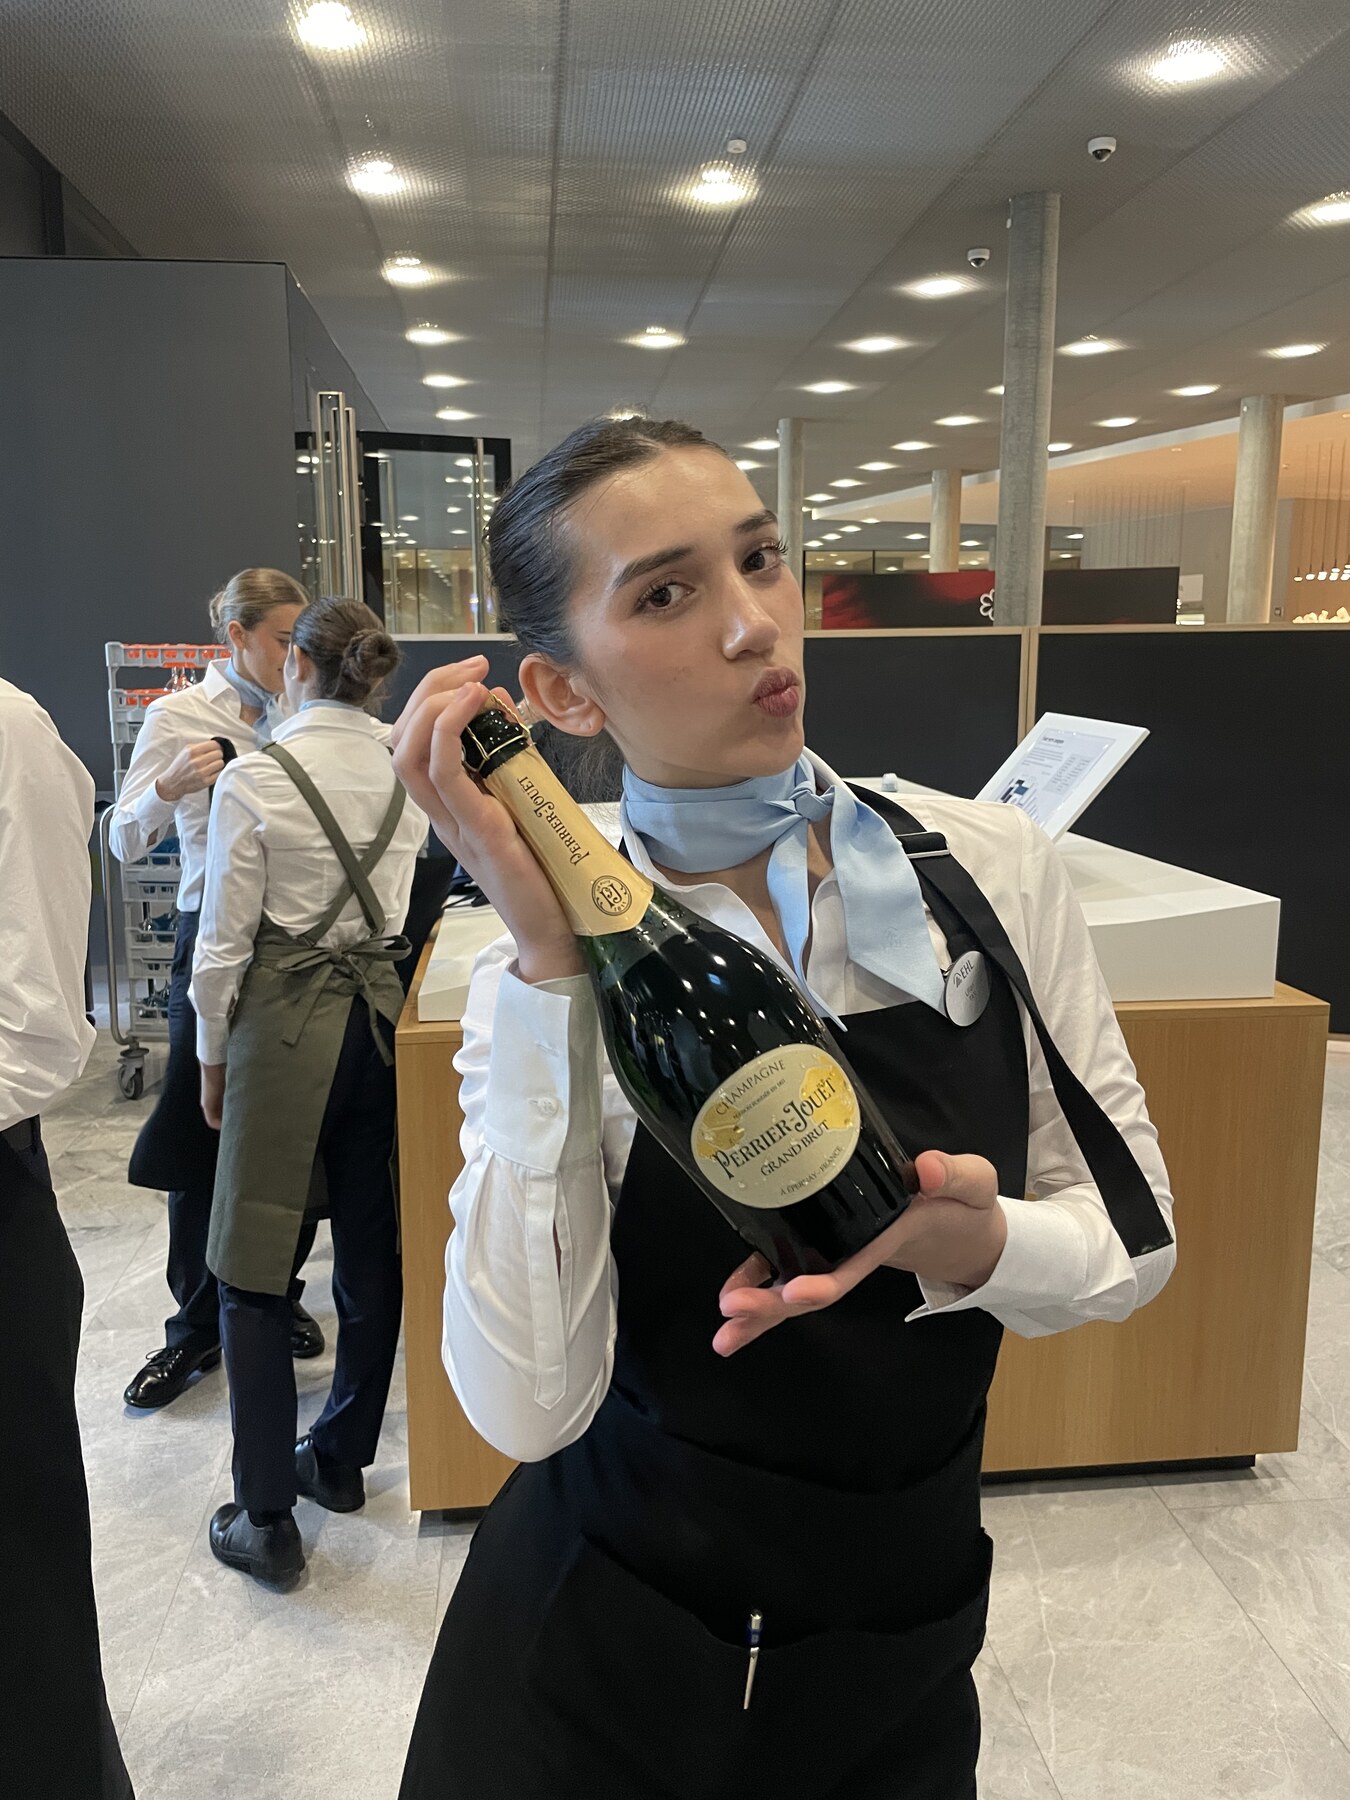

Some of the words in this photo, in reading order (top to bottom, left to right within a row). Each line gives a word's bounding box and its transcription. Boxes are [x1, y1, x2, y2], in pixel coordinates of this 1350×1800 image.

[960, 960, 974, 979] EHL
[716, 1059, 786, 1116] CHAMPAGNE
[760, 1143, 803, 1176] GRAND
[802, 1119, 831, 1148] BRUT
[819, 1146, 842, 1172] FRANCE
